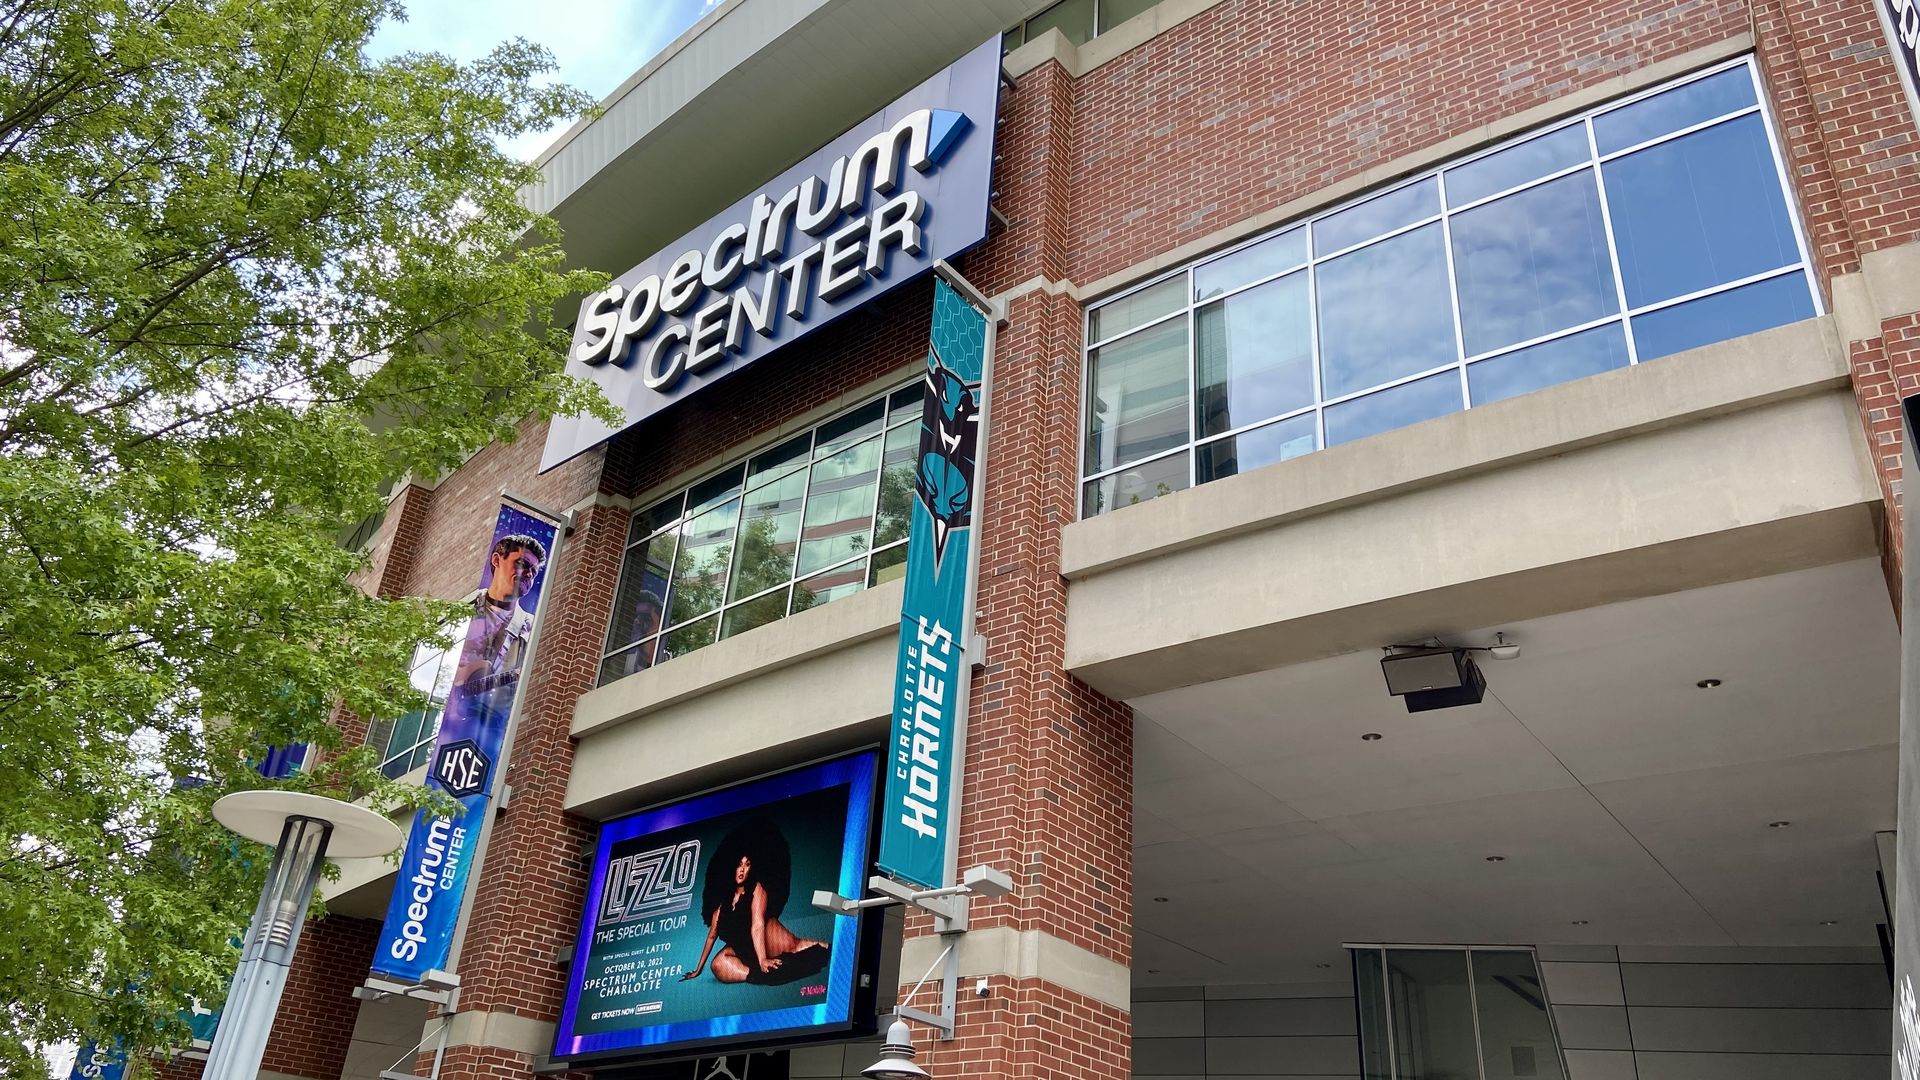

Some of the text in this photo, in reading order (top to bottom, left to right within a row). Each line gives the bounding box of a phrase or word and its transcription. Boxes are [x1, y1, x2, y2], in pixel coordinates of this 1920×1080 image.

[575, 108, 934, 368] Spectrum
[643, 190, 926, 393] CENTER
[897, 645, 918, 779] CHARLOTTE
[902, 615, 953, 839] HORNETS
[442, 747, 483, 791] HSE
[440, 827, 467, 891] CENTER
[598, 839, 701, 927] LIZZO
[391, 819, 452, 962] Spectrum
[596, 915, 688, 944] THE SPECIAL TOUR
[646, 942, 671, 954] LATTO
[584, 965, 682, 991] SPECTRUM CENTER
[600, 979, 662, 998] CHARLOTTE
[605, 961, 635, 974] OCTOBER
[648, 957, 663, 967] 2022
[591, 1011, 601, 1020] GET
[602, 1009, 621, 1019] TICKETS
[621, 1007, 635, 1016] NOW
